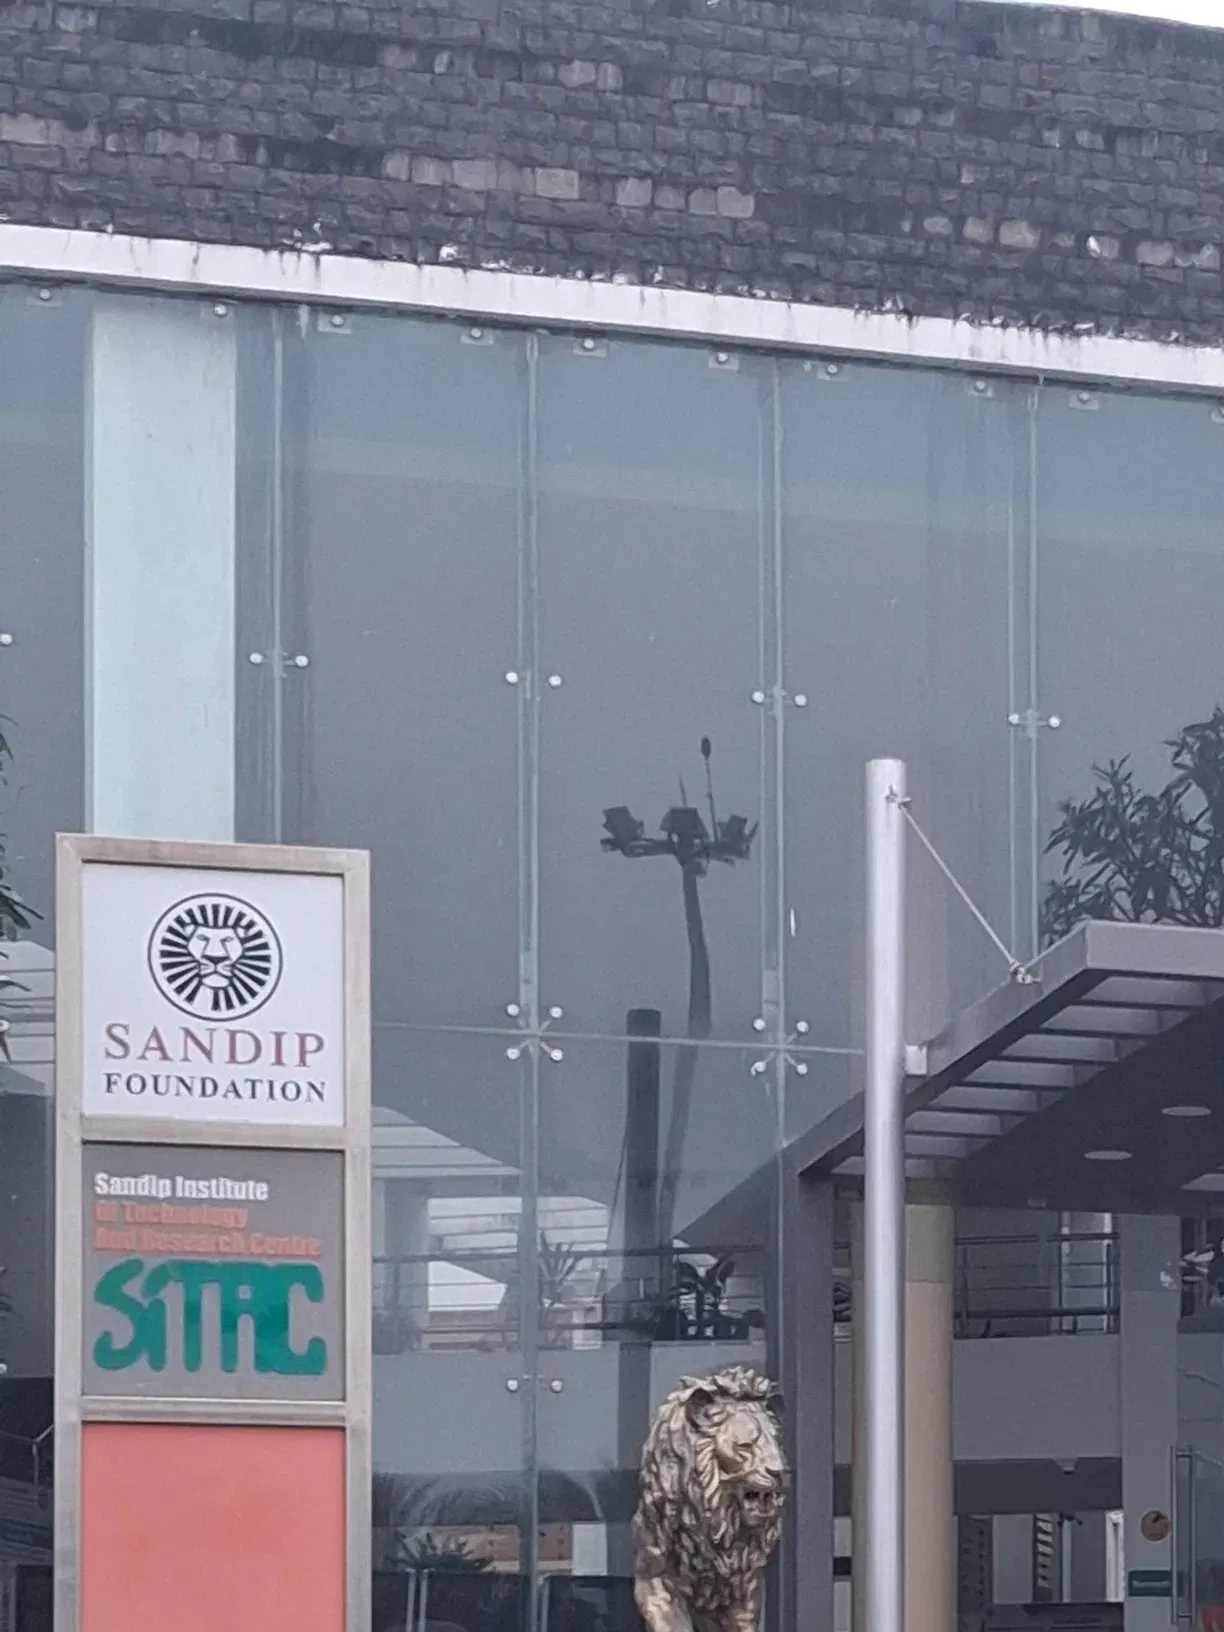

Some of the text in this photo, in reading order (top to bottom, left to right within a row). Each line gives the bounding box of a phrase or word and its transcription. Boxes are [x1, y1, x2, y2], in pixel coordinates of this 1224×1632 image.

[104, 1022, 325, 1067] SANDIP
[103, 1072, 326, 1103] FOUNDATION
[94, 1172, 269, 1201] Sandip Institute
[123, 1200, 248, 1228] Technology
[139, 1228, 248, 1254] Research
[250, 1232, 321, 1256] Centre
